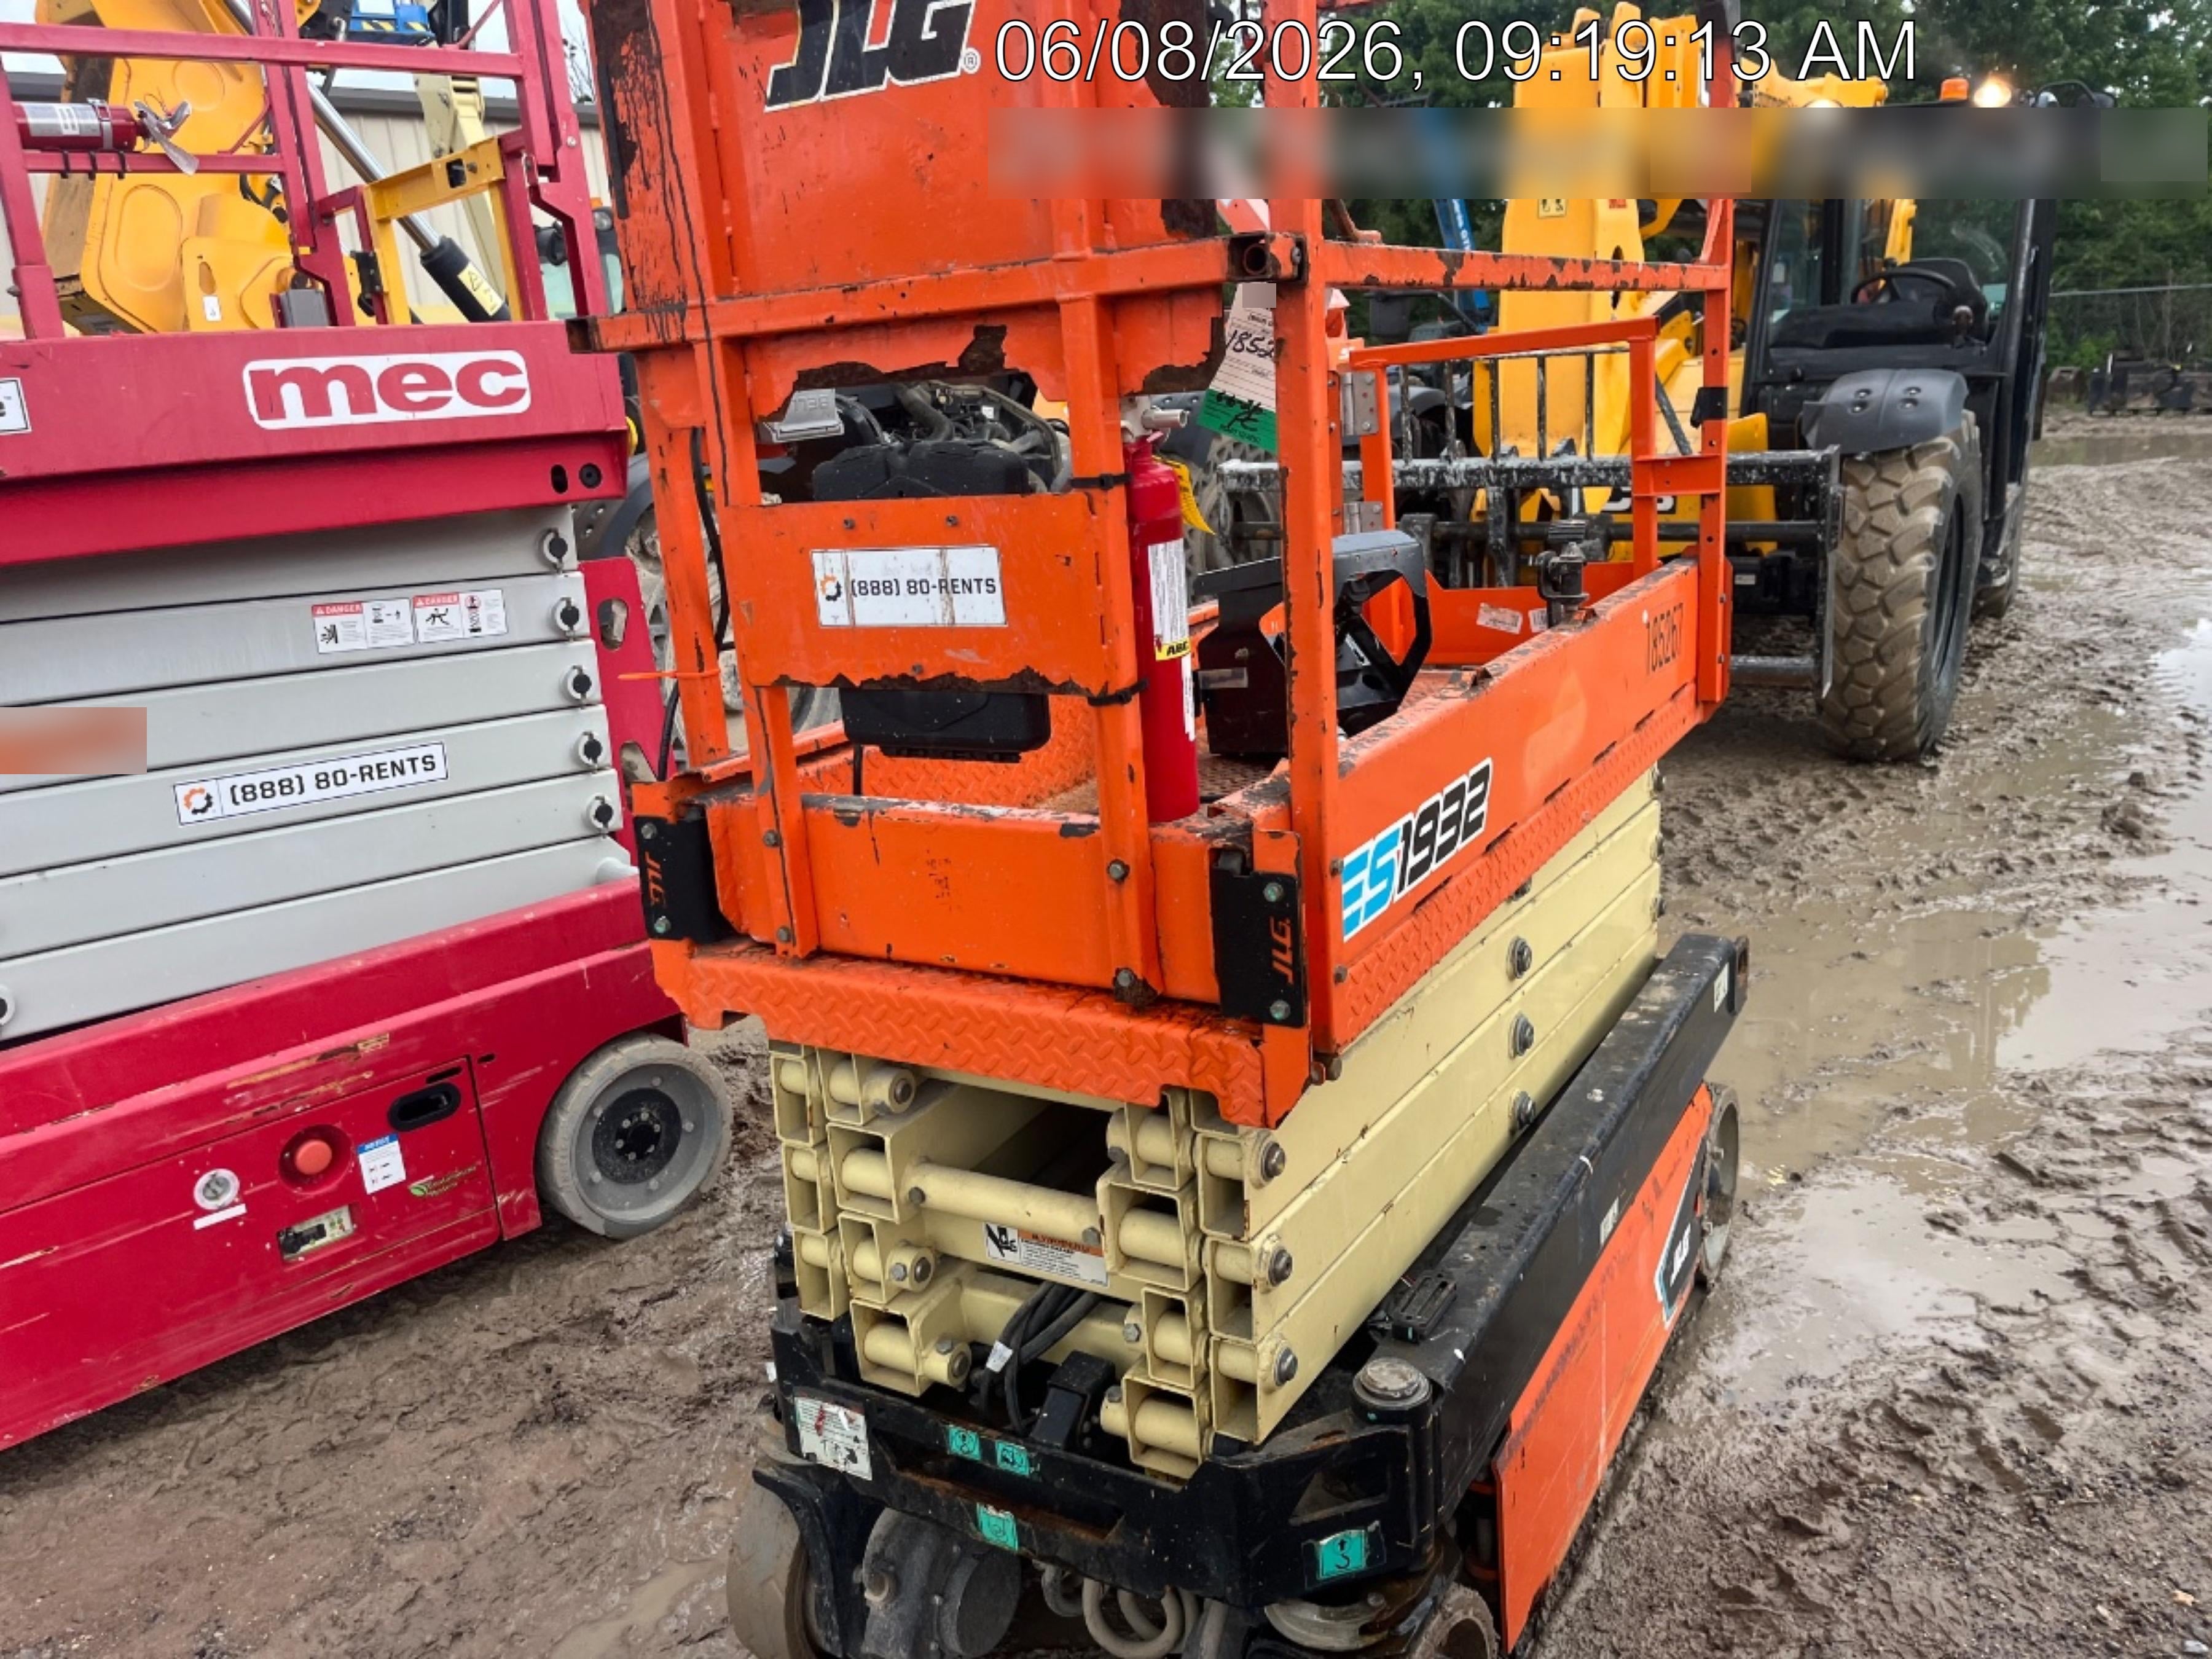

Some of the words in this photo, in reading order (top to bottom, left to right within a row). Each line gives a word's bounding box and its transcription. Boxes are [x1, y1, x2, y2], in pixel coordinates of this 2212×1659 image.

[765, 0, 975, 111] JLG
[248, 359, 527, 421] mec
[325, 602, 362, 615] DANGER
[425, 594, 458, 606] DANGER
[850, 578, 900, 597] (888)
[906, 578, 996, 595] 80-RENTS
[230, 774, 305, 806] (888)
[314, 755, 436, 790] 80-RENTS
[1342, 763, 1491, 937] ES1932
[1269, 915, 1293, 986] JLG
